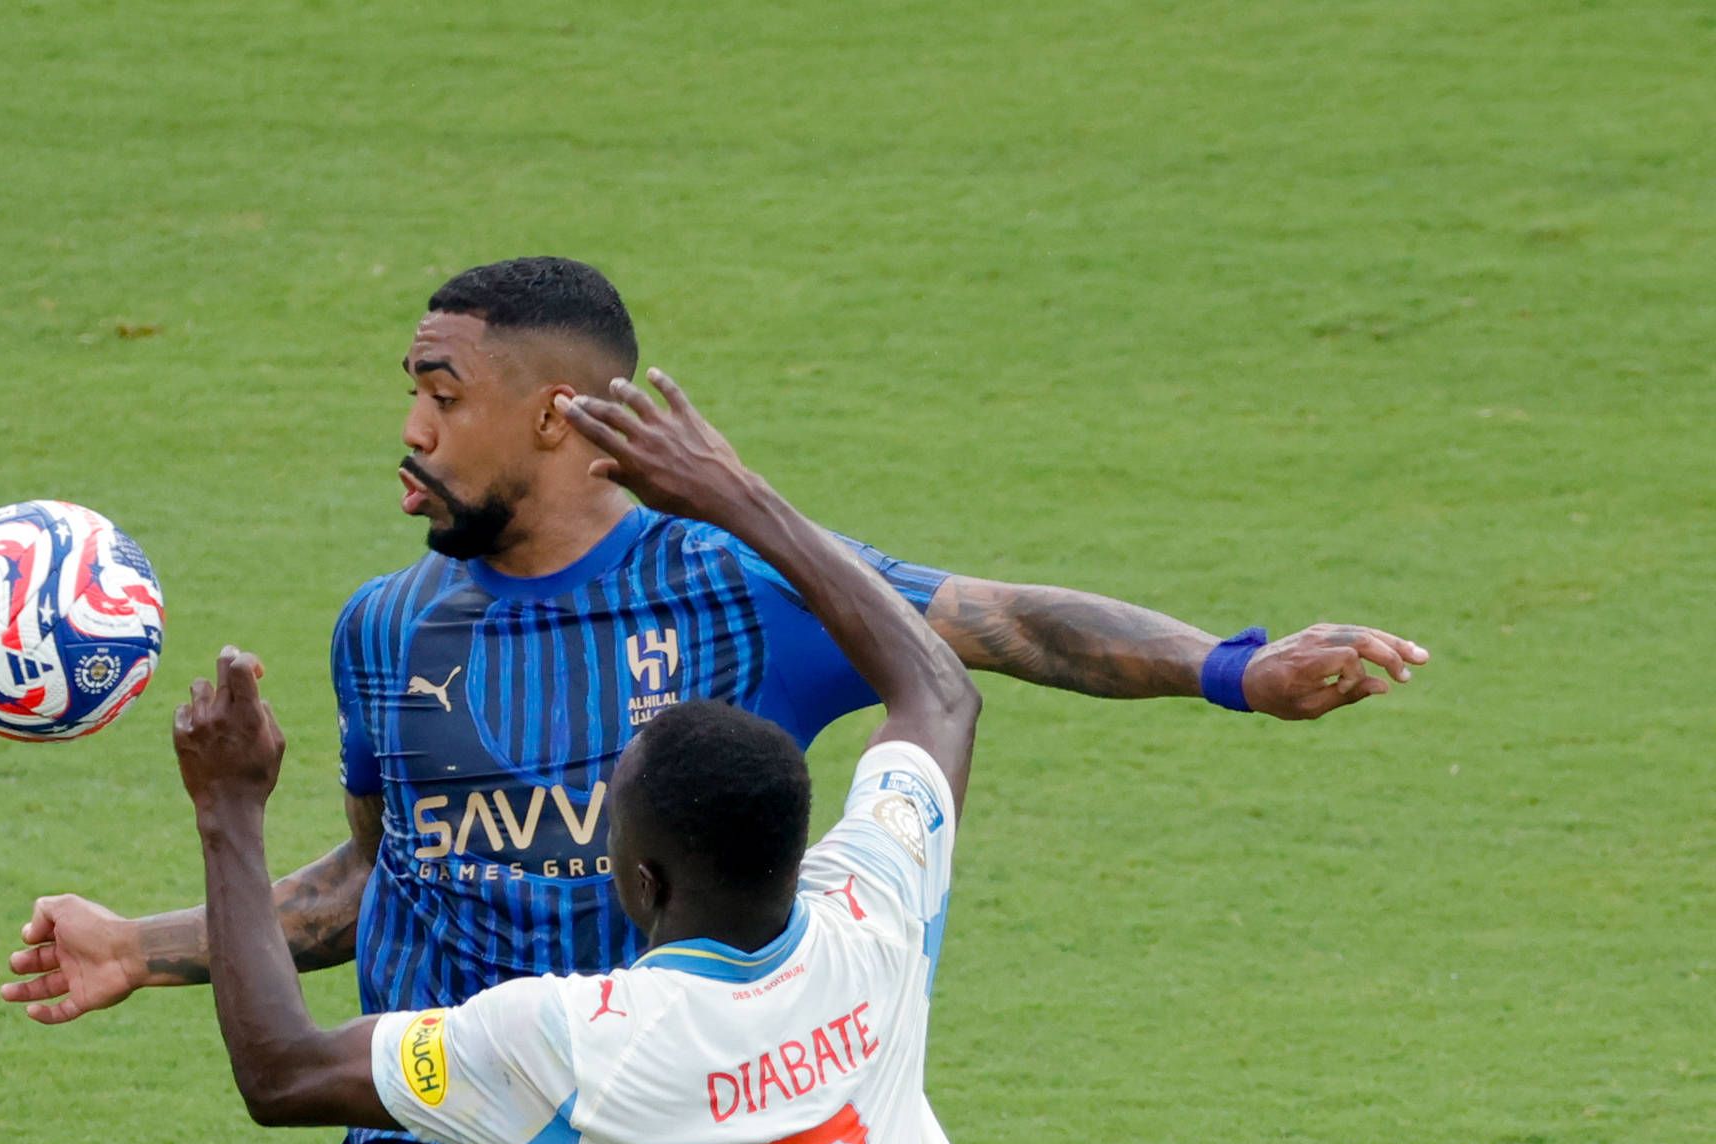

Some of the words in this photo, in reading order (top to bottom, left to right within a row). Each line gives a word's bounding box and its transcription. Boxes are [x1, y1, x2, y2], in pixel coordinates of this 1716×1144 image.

[628, 692, 680, 710] ALHILAL
[413, 781, 607, 859] SAVV
[418, 862, 525, 881] GAMES
[543, 856, 612, 879] GRO
[411, 1027, 440, 1093] RAUCH
[707, 1002, 880, 1123] DIABATE
